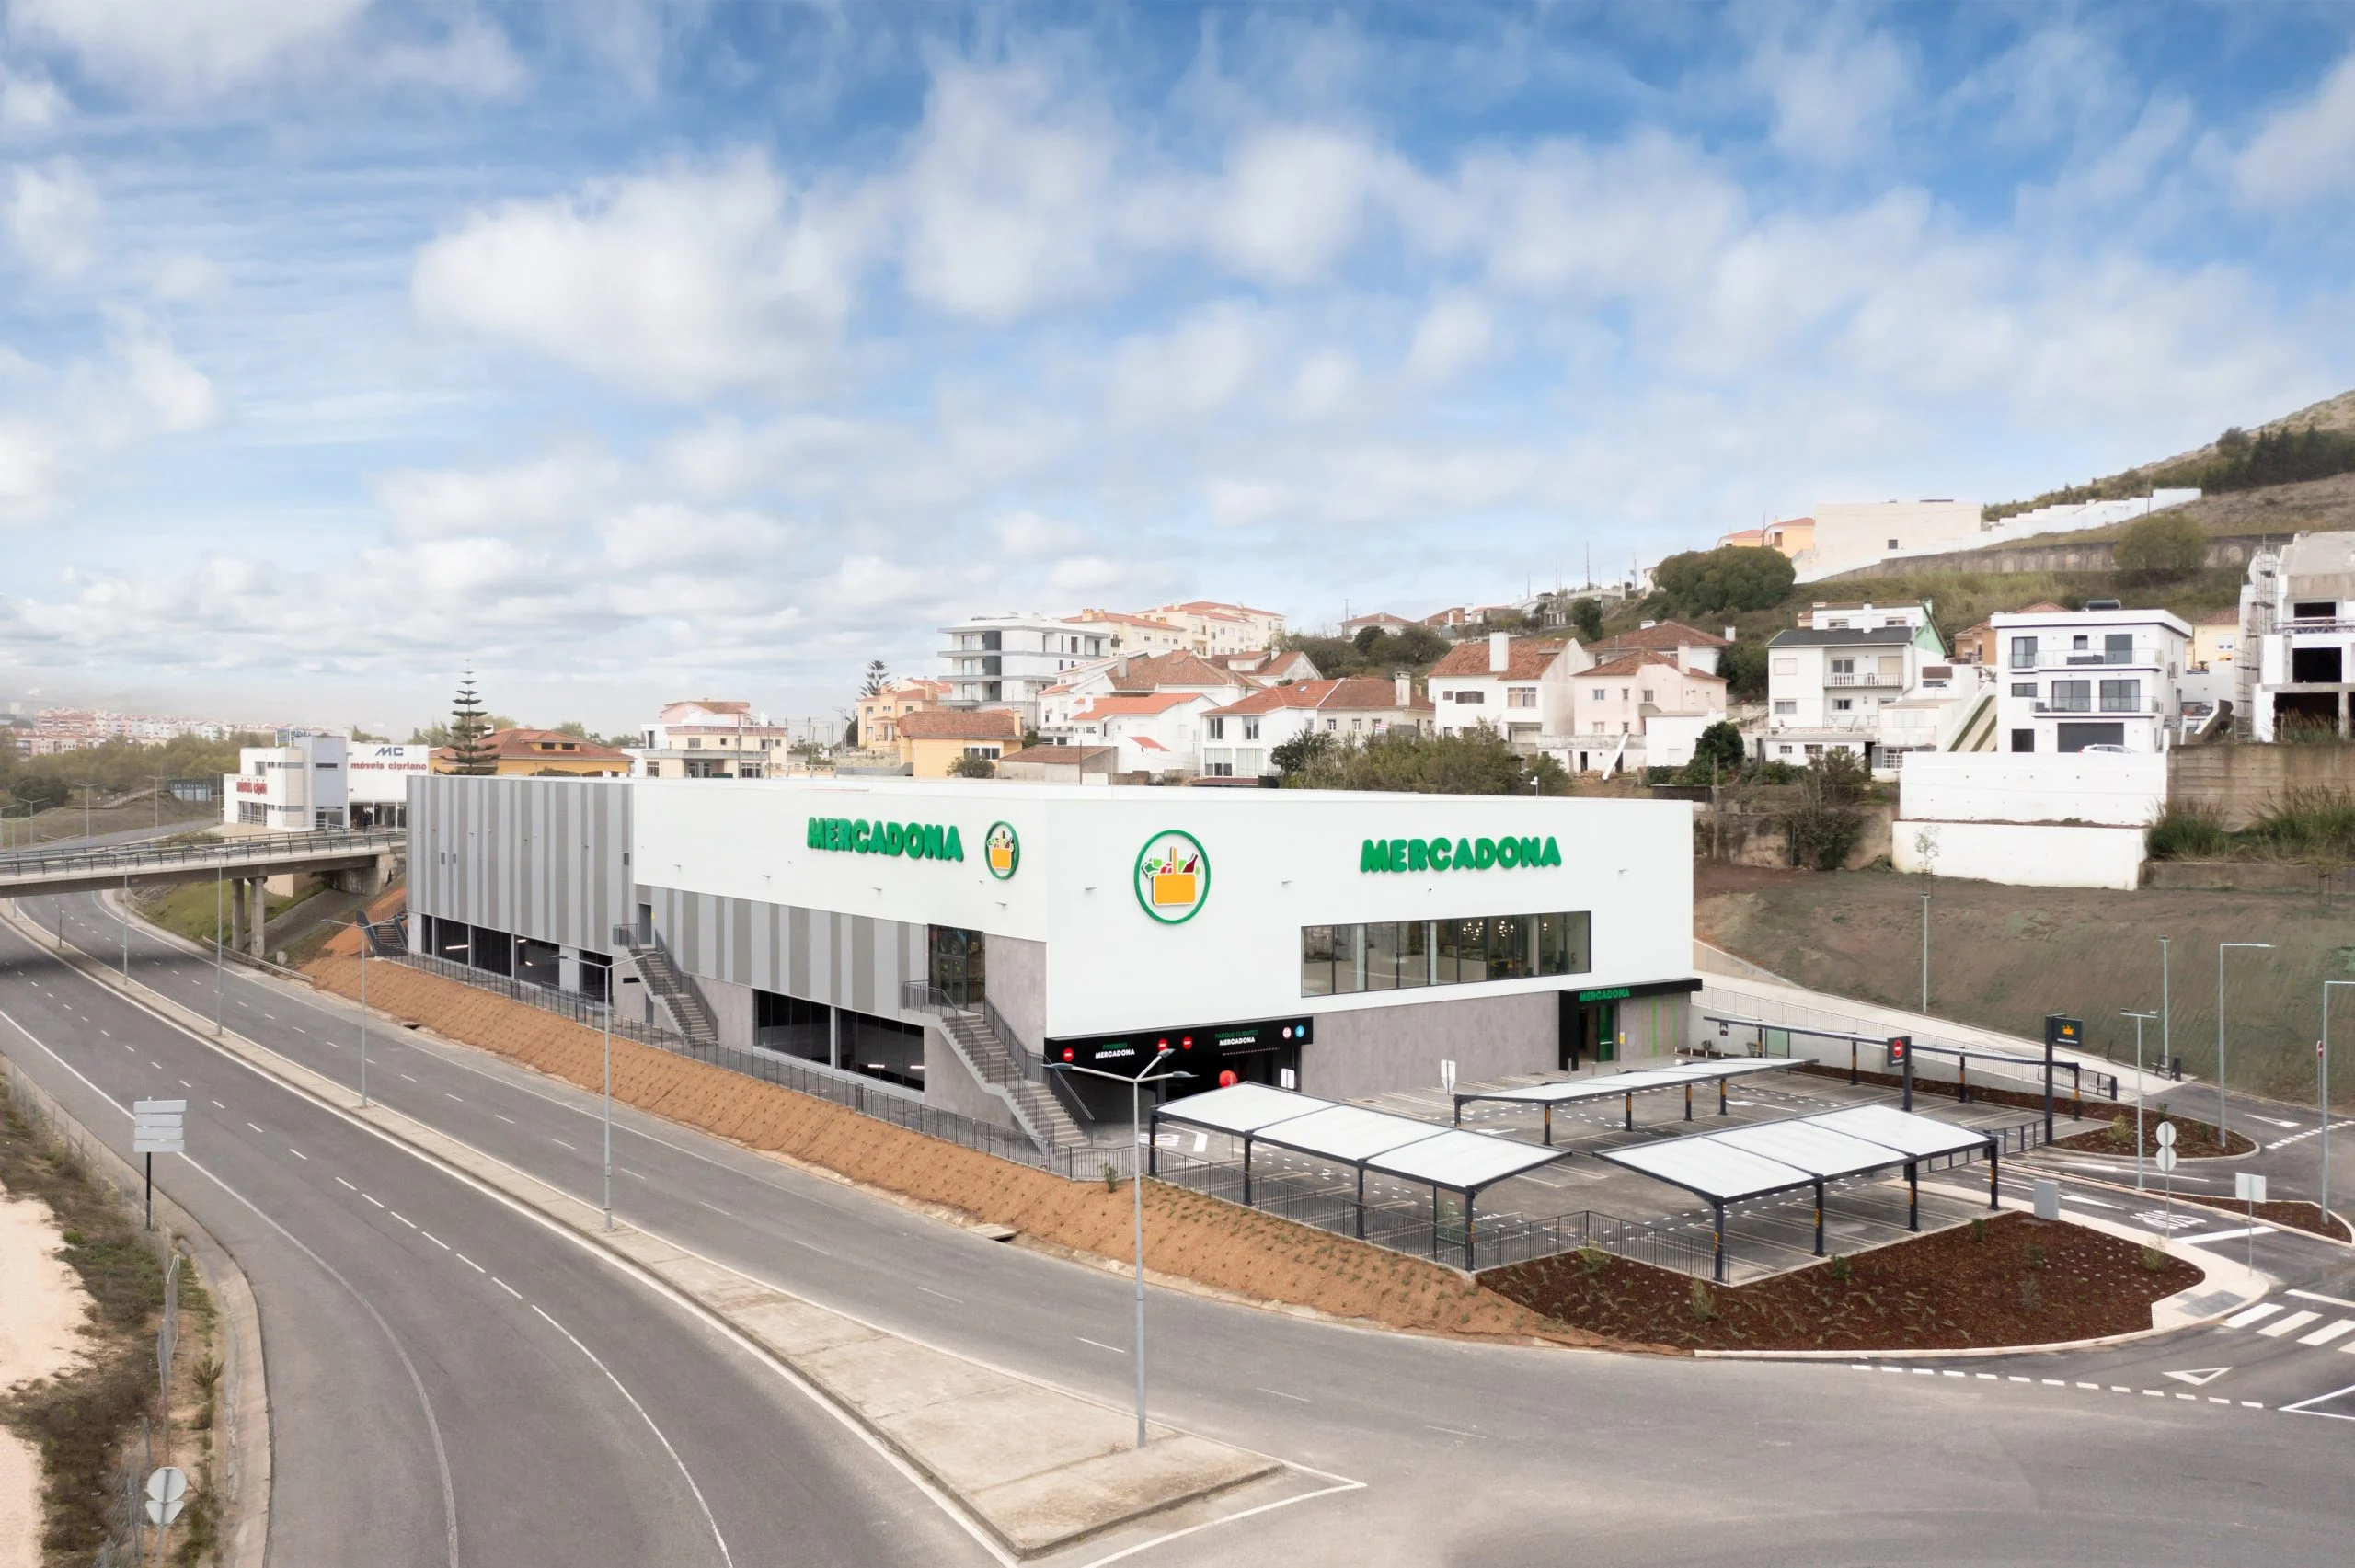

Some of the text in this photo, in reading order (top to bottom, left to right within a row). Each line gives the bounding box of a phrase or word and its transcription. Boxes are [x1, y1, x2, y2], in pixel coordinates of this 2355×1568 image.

[375, 747, 404, 757] MC
[388, 761, 427, 771] cipriano
[807, 817, 965, 862] MERCADONA
[1360, 836, 1562, 873] MERCADONA
[1579, 988, 1630, 1002] MERCADONA
[1219, 1036, 1256, 1047] MERCADONA
[1095, 1048, 1135, 1059] MERCADONA
